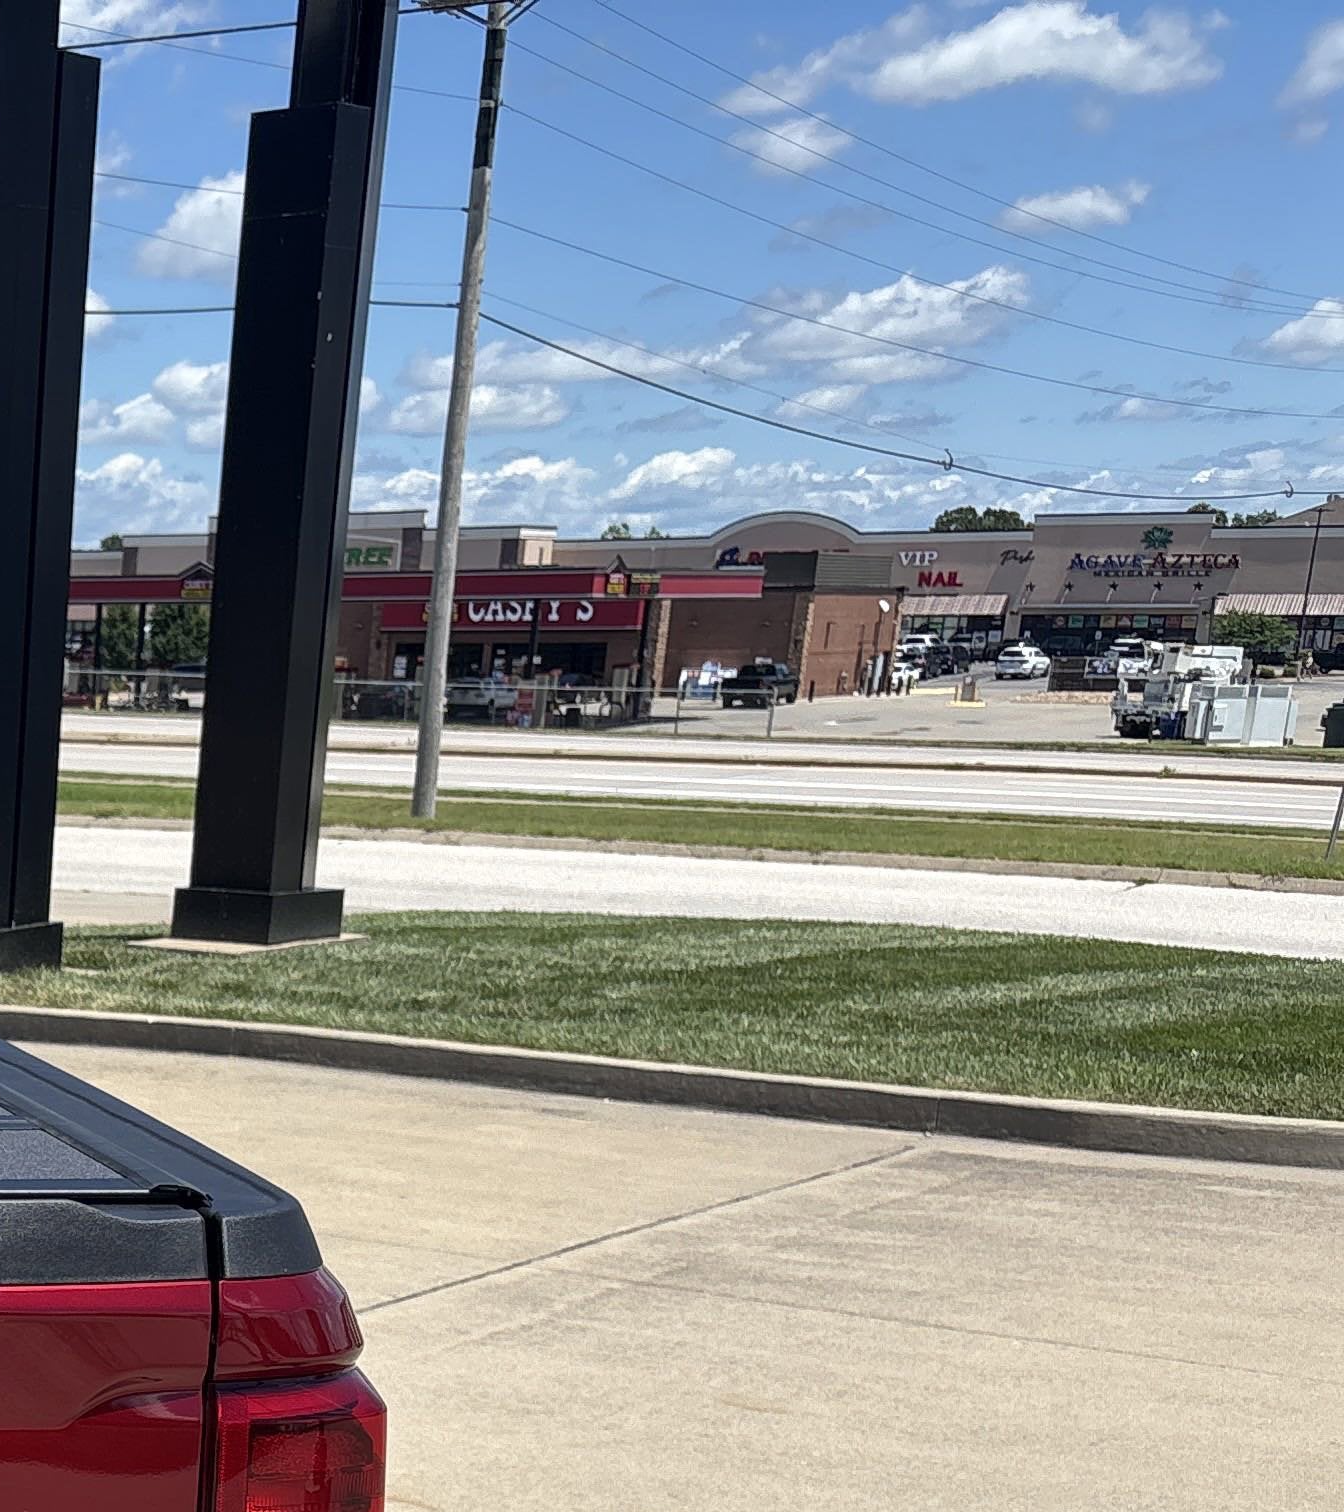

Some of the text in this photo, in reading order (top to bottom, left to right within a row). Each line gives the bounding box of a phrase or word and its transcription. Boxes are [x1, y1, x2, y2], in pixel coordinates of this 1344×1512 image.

[898, 551, 938, 567] VIP
[1069, 552, 1241, 570] AGAVE AZTECA
[918, 571, 963, 587] NAIL
[468, 600, 594, 622] CASYS
